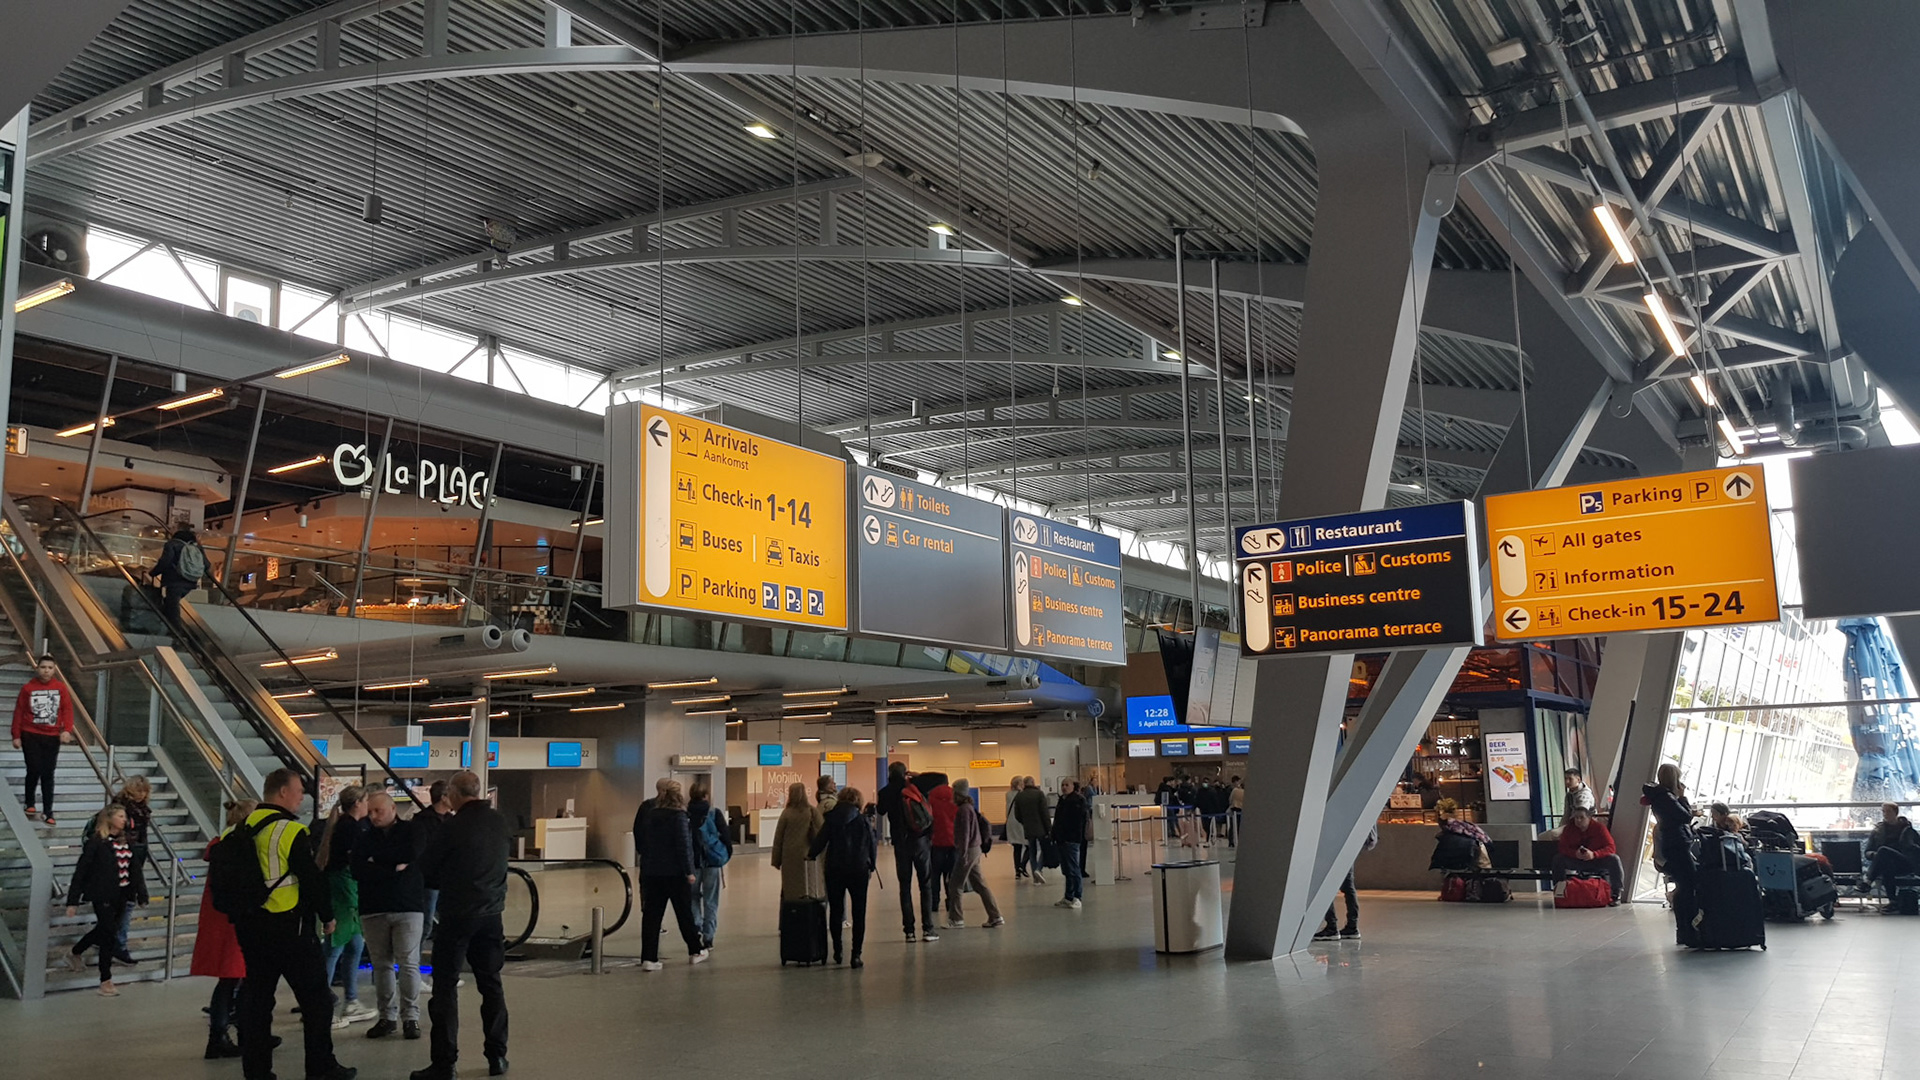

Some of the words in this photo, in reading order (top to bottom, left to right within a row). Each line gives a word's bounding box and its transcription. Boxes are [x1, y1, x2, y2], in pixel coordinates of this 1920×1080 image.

[703, 428, 759, 457] Arrivals
[703, 449, 749, 471] Aankomst
[385, 453, 409, 495] La
[702, 483, 762, 512] Check-in
[766, 494, 812, 529] 1-14
[917, 494, 950, 516] Toilets
[1612, 486, 1682, 506] Parking
[1315, 519, 1402, 540] Restaurant
[1562, 533, 1585, 549] All
[1593, 529, 1642, 548] gates
[702, 530, 743, 553] Buses
[903, 529, 922, 547] Car
[923, 536, 953, 554] rental
[1053, 531, 1095, 553] Restaurant
[788, 546, 820, 567] Taxis
[1380, 550, 1451, 568] Customs
[1043, 562, 1067, 579] Police
[1296, 560, 1341, 576] Police
[1564, 564, 1675, 585] Information
[1084, 571, 1115, 589] Customs
[703, 577, 756, 605] Parking
[1298, 592, 1365, 609] Business
[1369, 588, 1421, 603] centre
[1045, 596, 1078, 614] Business
[1080, 604, 1103, 618] centre
[1568, 603, 1646, 621] Check-in
[1651, 591, 1744, 621] 15-24
[1046, 630, 1085, 647] Panorama
[1087, 635, 1113, 651] terrace
[1300, 624, 1379, 642] Panorama
[1383, 620, 1442, 637] terrace
[1144, 720, 1158, 728] April
[1145, 709, 1168, 718] 12:28
[768, 772, 802, 783] Mobility
